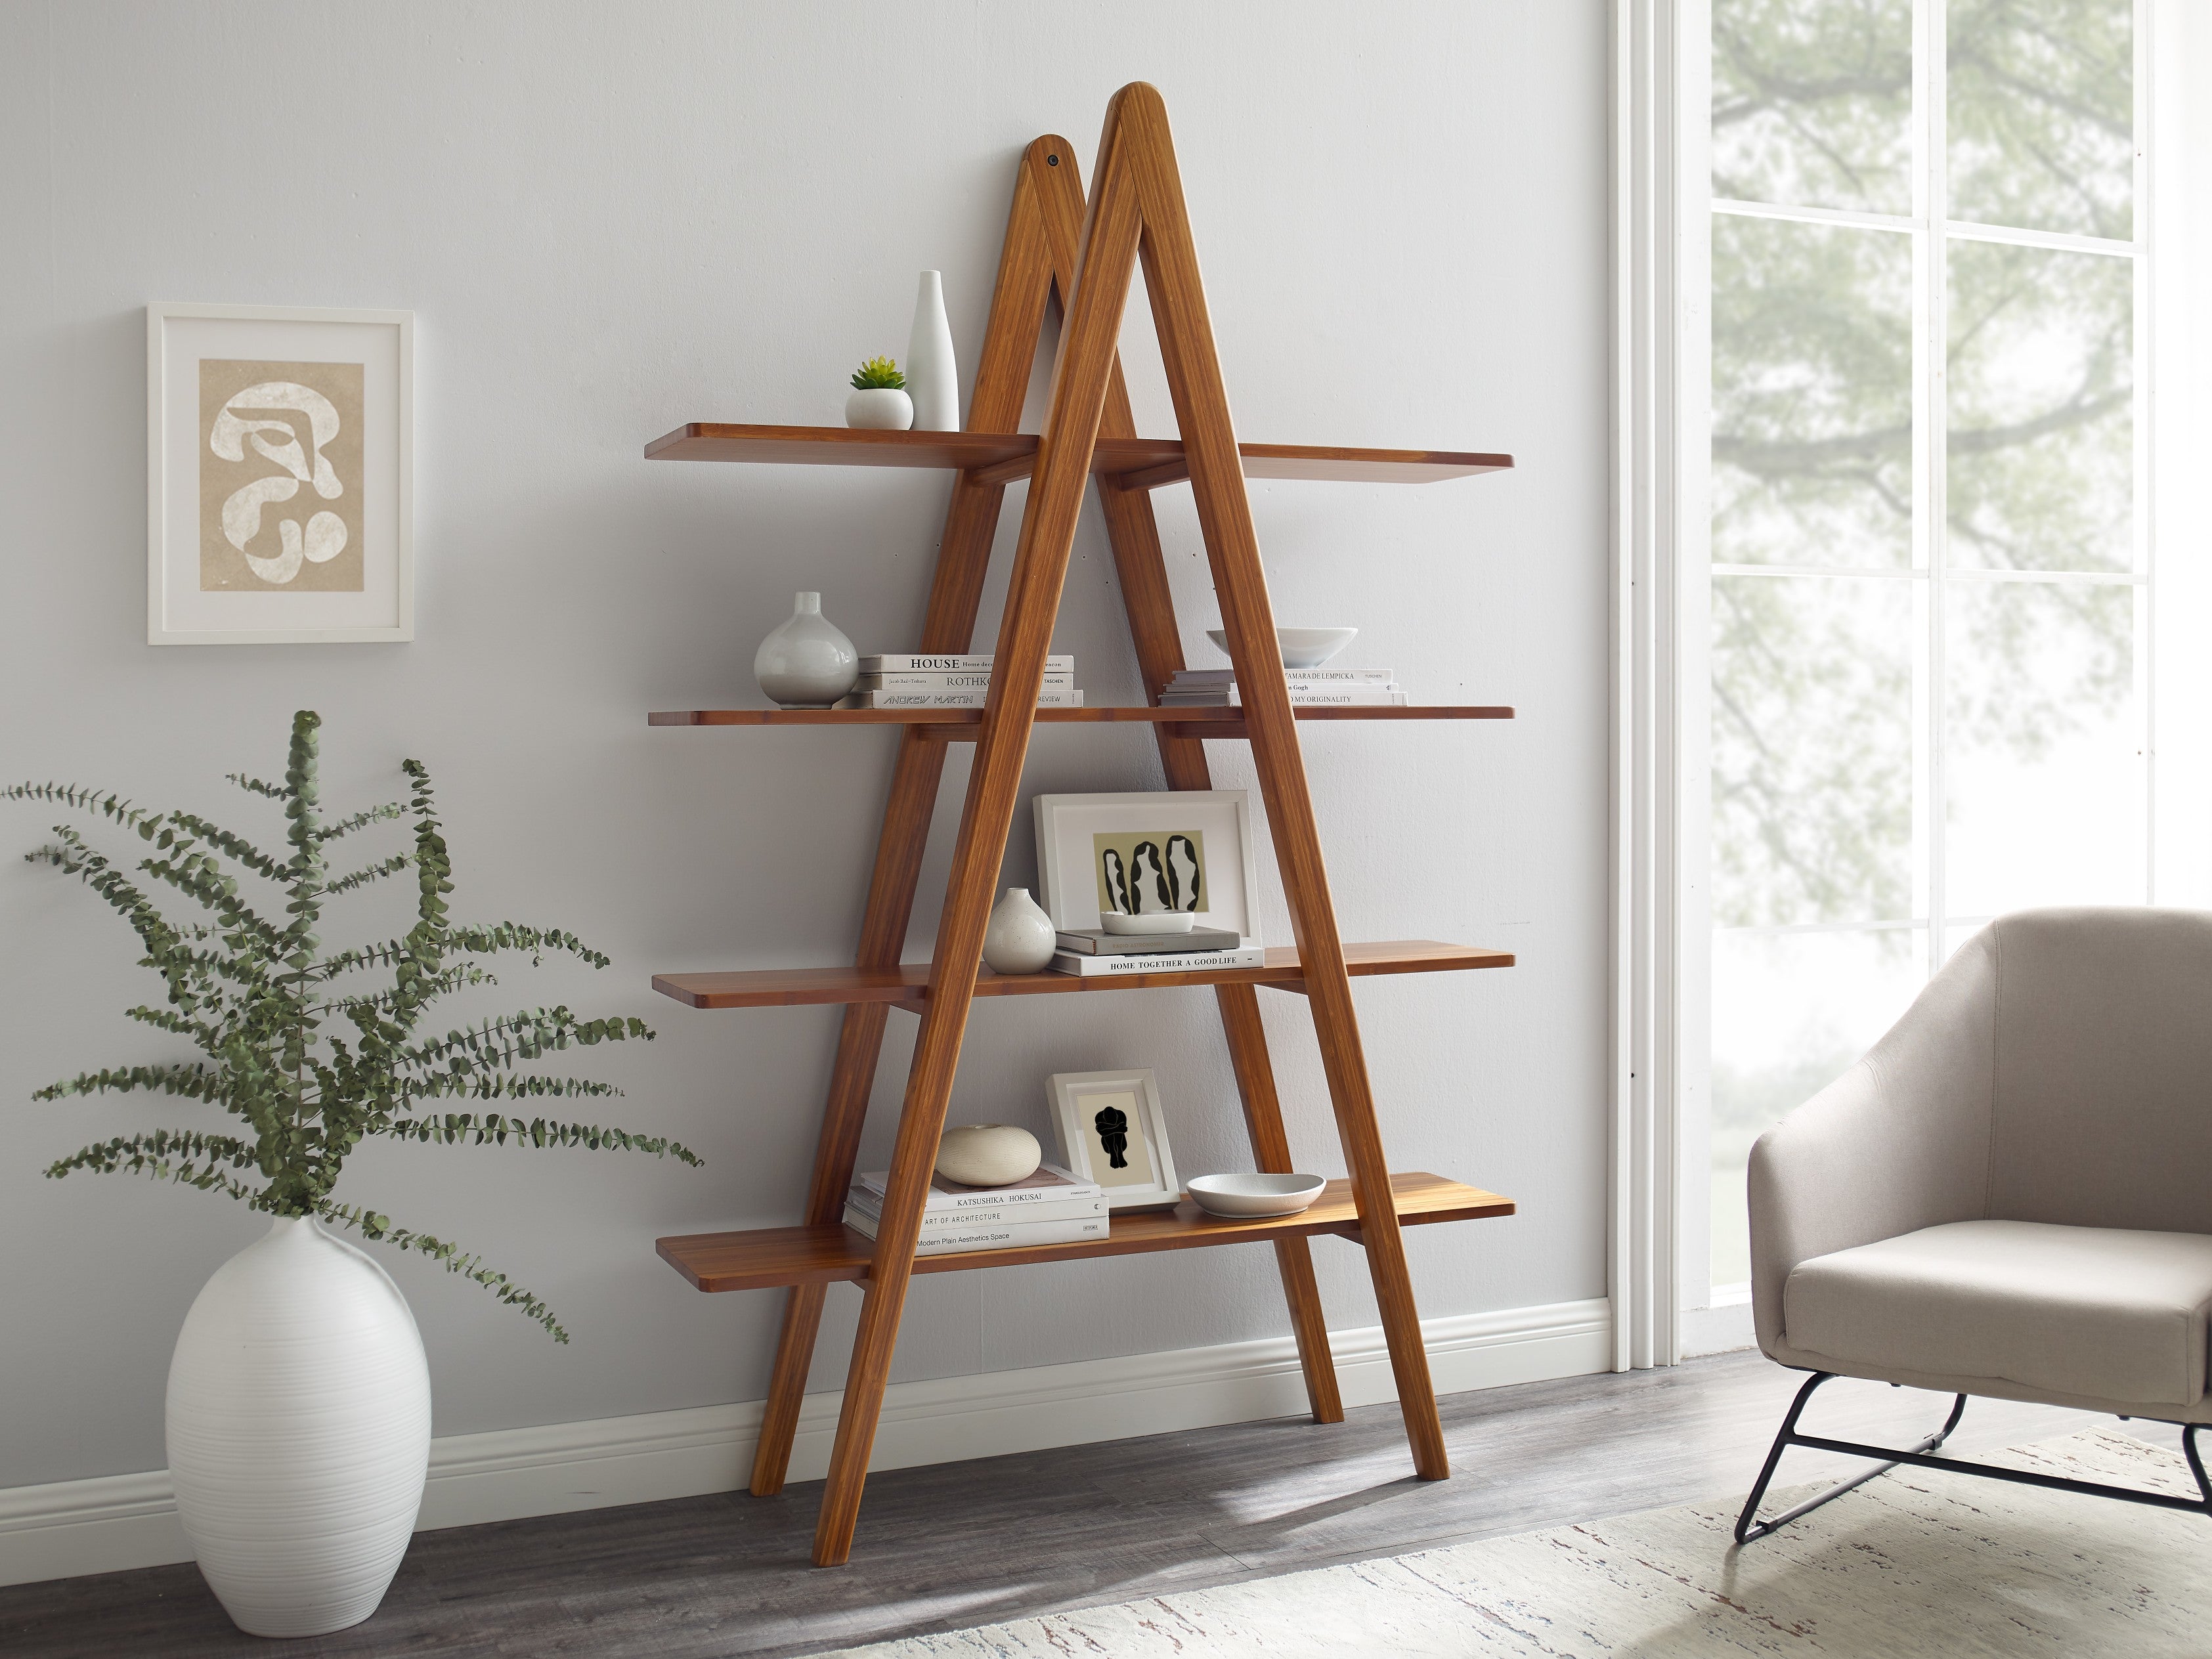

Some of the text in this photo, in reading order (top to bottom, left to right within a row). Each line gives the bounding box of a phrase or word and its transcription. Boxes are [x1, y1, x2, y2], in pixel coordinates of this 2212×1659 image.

[910, 658, 960, 668] HOUSE
[934, 695, 974, 704] MARTIN
[1138, 960, 1182, 968] TOGETHER
[957, 1193, 1042, 1207] KATSUSHIKA HOKUSAI
[951, 1213, 1001, 1223] ARCHITECTURE
[958, 1234, 989, 1243] Aesthetics
